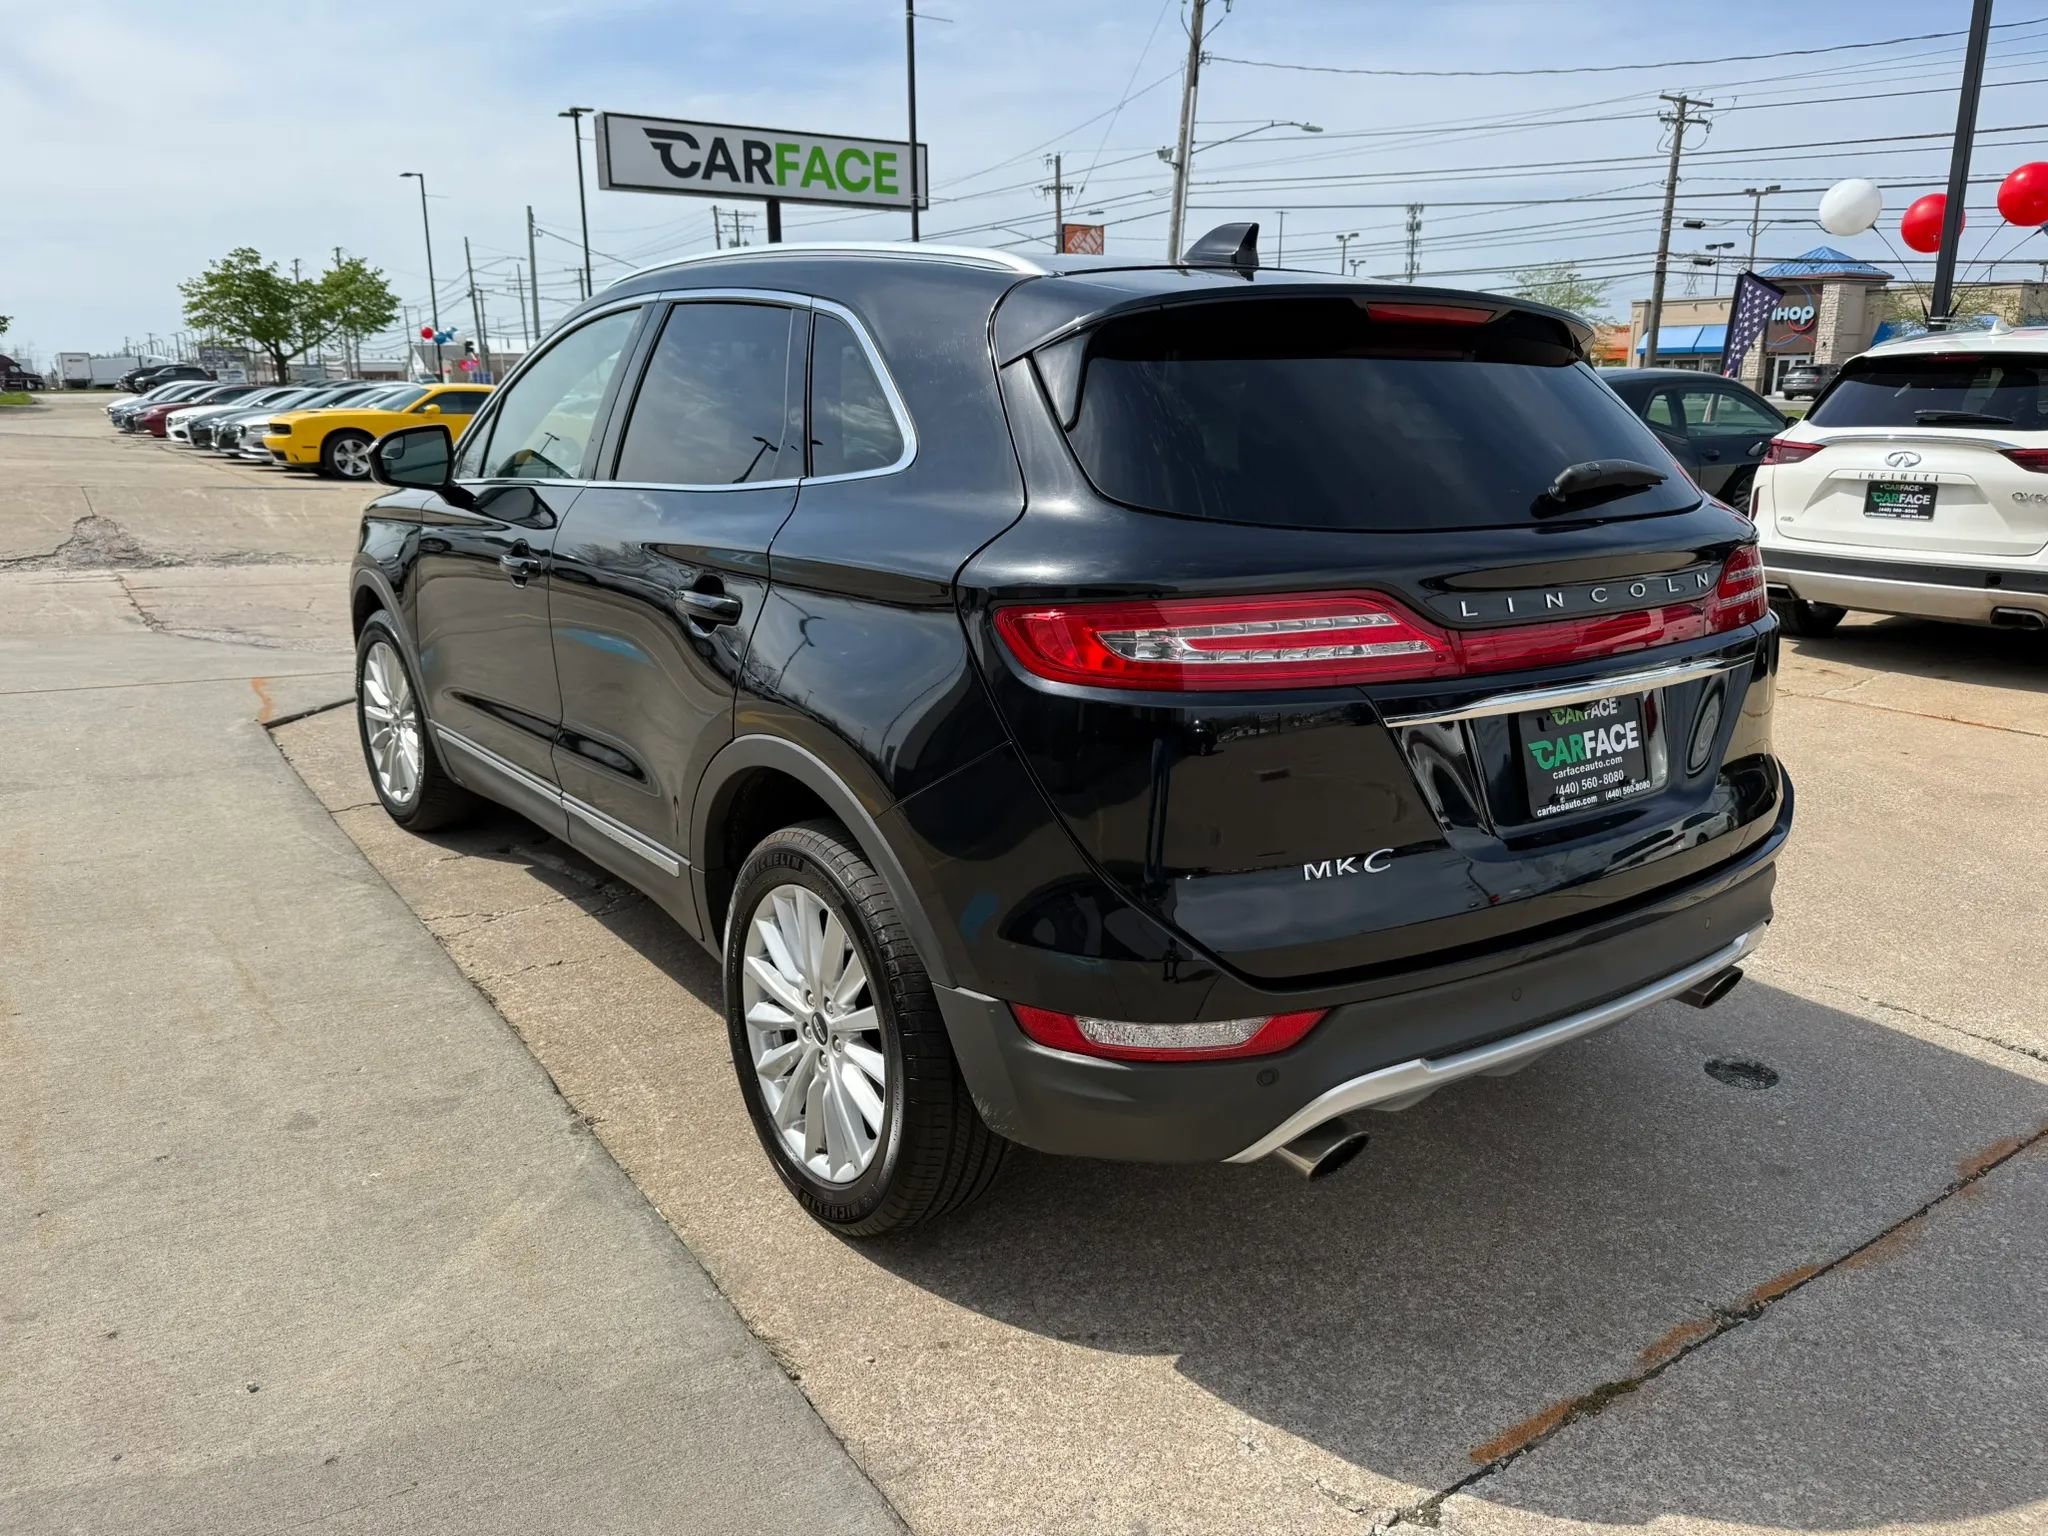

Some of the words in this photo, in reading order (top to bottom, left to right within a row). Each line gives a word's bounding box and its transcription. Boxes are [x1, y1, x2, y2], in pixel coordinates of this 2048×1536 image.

[642, 127, 899, 195] CARFACE
[1859, 472, 1939, 482] INFINITI
[1871, 491, 1931, 505] CARFACE
[1460, 572, 1709, 617] LINCOLN
[1528, 720, 1640, 771] CARFACE
[1552, 755, 1623, 780] carfaceauto.com
[1555, 781, 1580, 796] (440)
[1605, 788, 1622, 800] (440)
[1536, 795, 1598, 817] carfaceauto.com
[1303, 848, 1395, 881] MKC
